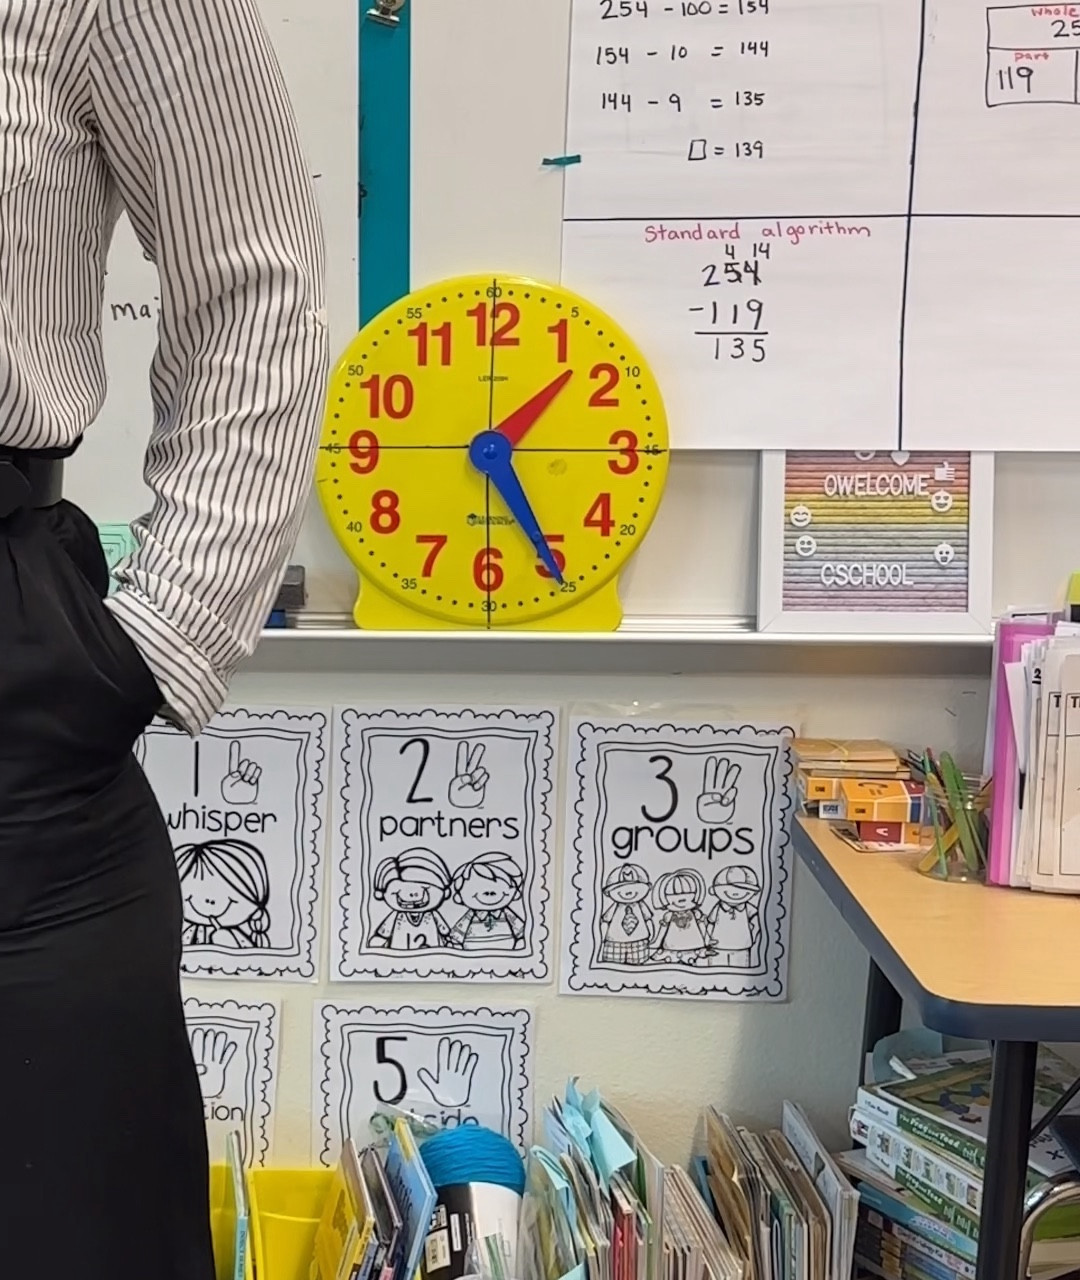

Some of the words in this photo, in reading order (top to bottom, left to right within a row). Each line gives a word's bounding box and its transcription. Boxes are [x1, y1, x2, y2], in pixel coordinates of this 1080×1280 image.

[1032, 5, 1079, 17] whole
[596, 46, 629, 65] 154
[671, 45, 687, 60] 10
[741, 40, 769, 57] 144
[1015, 52, 1049, 62] part
[999, 66, 1033, 93] 119
[602, 93, 631, 112] 144
[735, 91, 765, 106] 135
[735, 140, 763, 159] 139
[645, 222, 740, 243] Standard
[762, 221, 870, 245] algorithm
[725, 244, 735, 259] 4
[753, 243, 770, 259] 14
[406, 308, 422, 319] 55
[466, 302, 520, 346] 12
[571, 306, 579, 318] 5
[407, 322, 452, 366] 11
[548, 319, 568, 362] 1
[714, 337, 766, 363] 135
[588, 363, 619, 407] 2
[625, 366, 640, 378] 10
[359, 374, 413, 419] 10
[348, 430, 379, 474] 9
[608, 430, 639, 474] 3
[824, 474, 929, 497] OWELCOME
[370, 490, 401, 534] 8
[583, 493, 615, 537] 4
[620, 524, 636, 536] 20
[416, 535, 448, 577] 7
[473, 548, 503, 592] 6
[820, 563, 913, 586] CSCHOOL
[399, 739, 433, 803] 2
[641, 755, 679, 821] 3
[380, 812, 519, 840] partners
[611, 823, 754, 859] groups
[373, 1035, 408, 1105] 5
